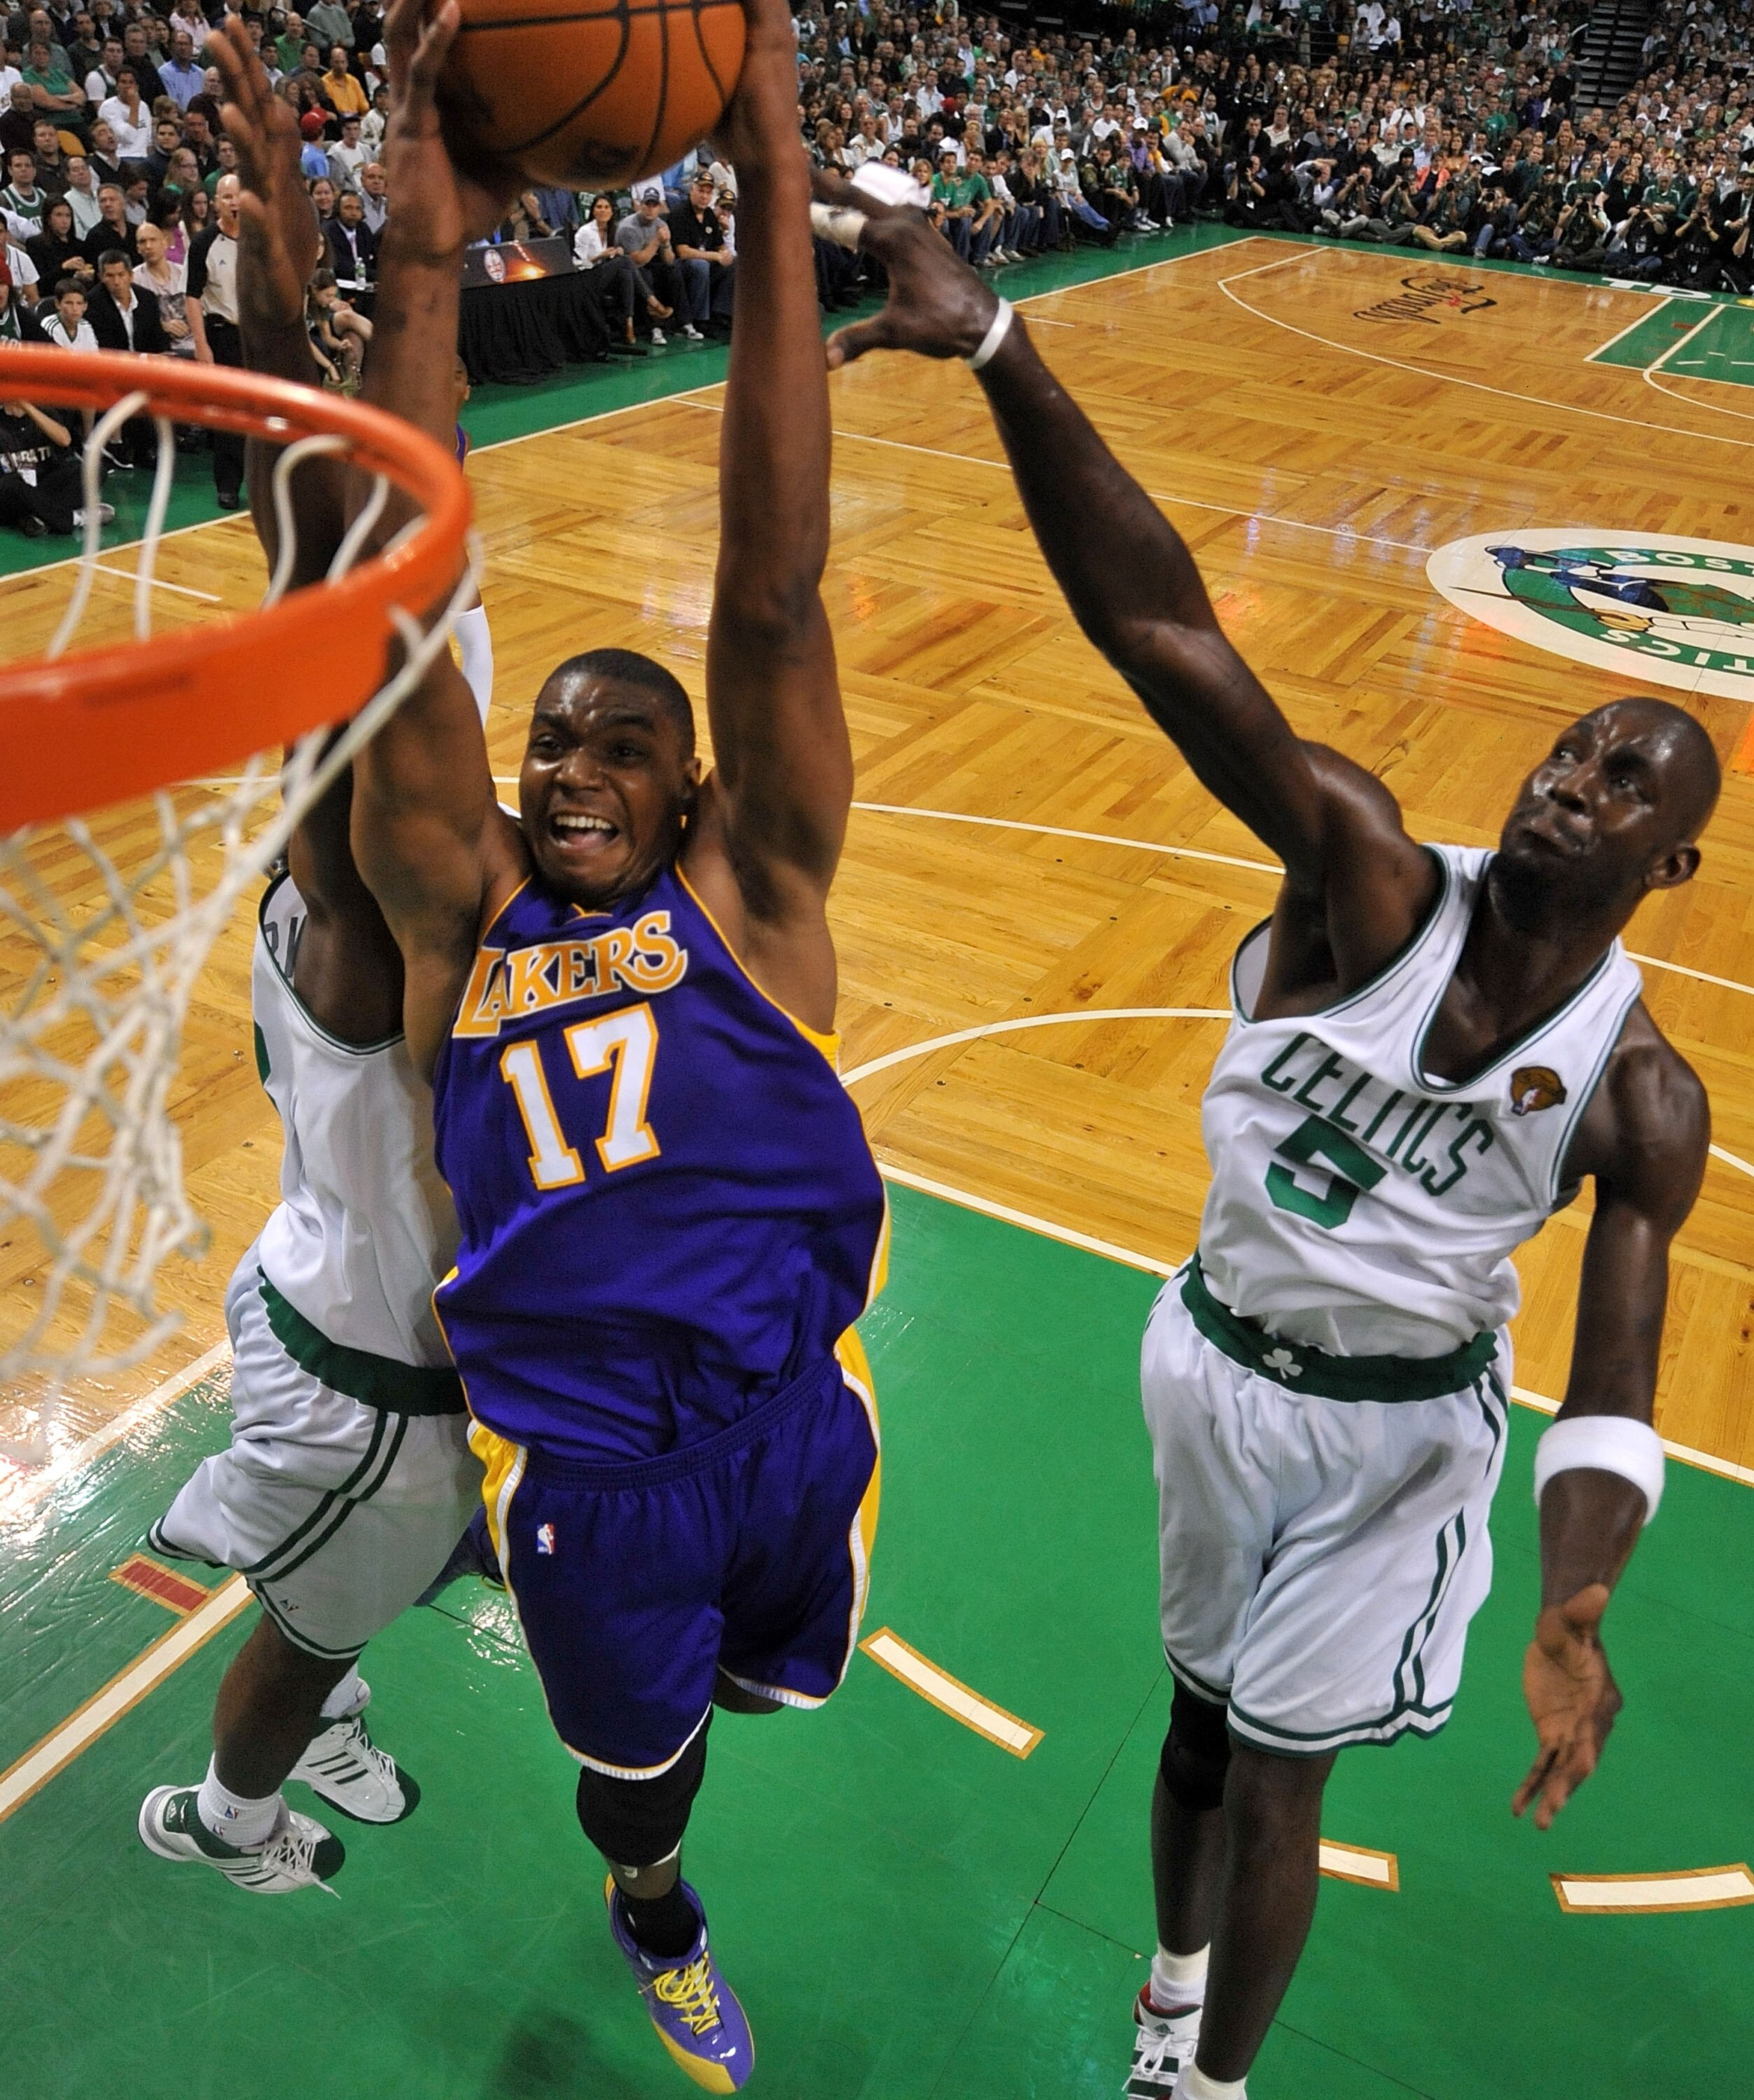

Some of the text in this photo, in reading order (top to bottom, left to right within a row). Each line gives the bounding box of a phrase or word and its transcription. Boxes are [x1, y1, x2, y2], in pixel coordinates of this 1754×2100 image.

[452, 910, 688, 1039] LAKERS
[500, 1002, 662, 1190] 17
[1261, 1032, 1494, 1196] CELTICS
[1265, 1114, 1388, 1230] 5
